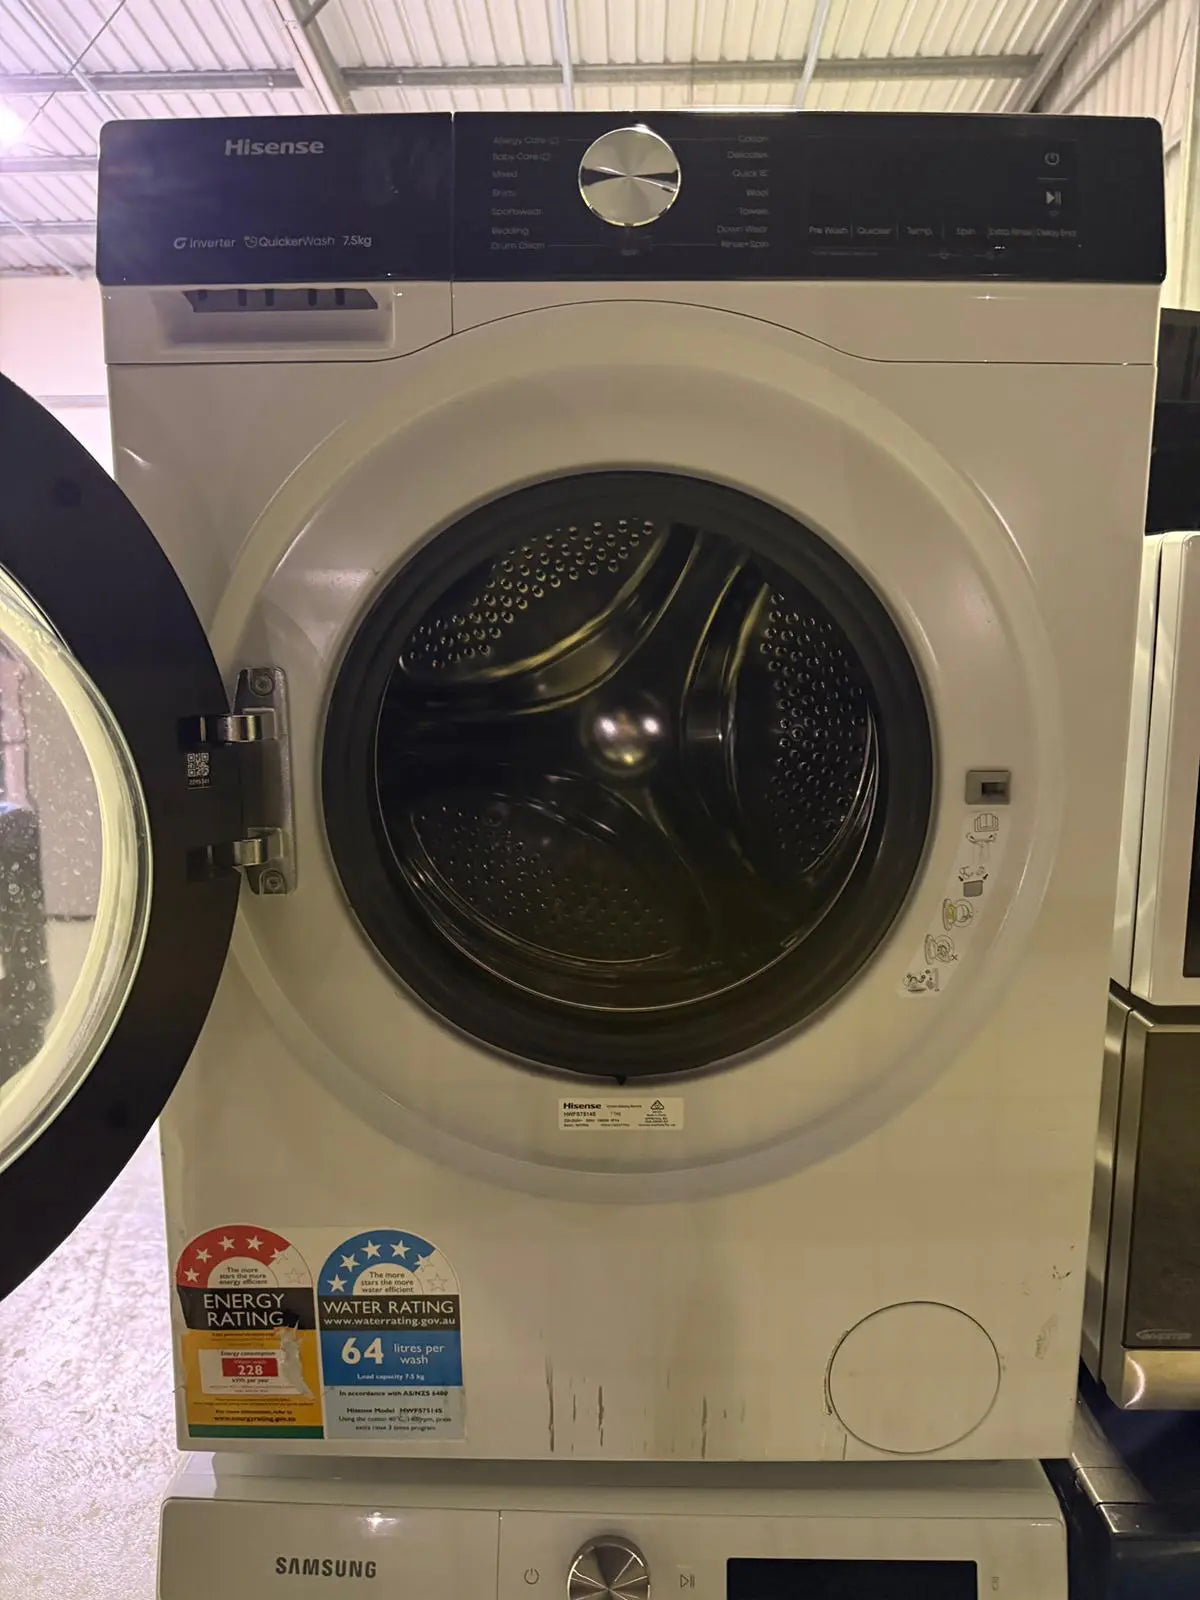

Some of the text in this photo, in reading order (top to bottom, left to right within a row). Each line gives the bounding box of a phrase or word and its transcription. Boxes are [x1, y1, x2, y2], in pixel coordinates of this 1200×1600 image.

[225, 138, 324, 156] Hisense
[824, 226, 848, 235] Wash
[190, 235, 372, 249] Inverter QuickerWash 7.5kg
[563, 1102, 601, 1110] Hisense
[204, 1293, 285, 1310] ENERGY
[323, 1300, 454, 1314] WATER RATING
[207, 1311, 284, 1327] RATING
[324, 1316, 456, 1327] www.waterrating.gov.au
[221, 1351, 239, 1359] Energy
[341, 1337, 384, 1365] 64
[393, 1344, 446, 1355] litres per
[400, 1354, 428, 1365] wash
[238, 1365, 264, 1375] 228
[376, 1374, 403, 1382] capacity
[275, 1556, 377, 1579] SAMSUNG
